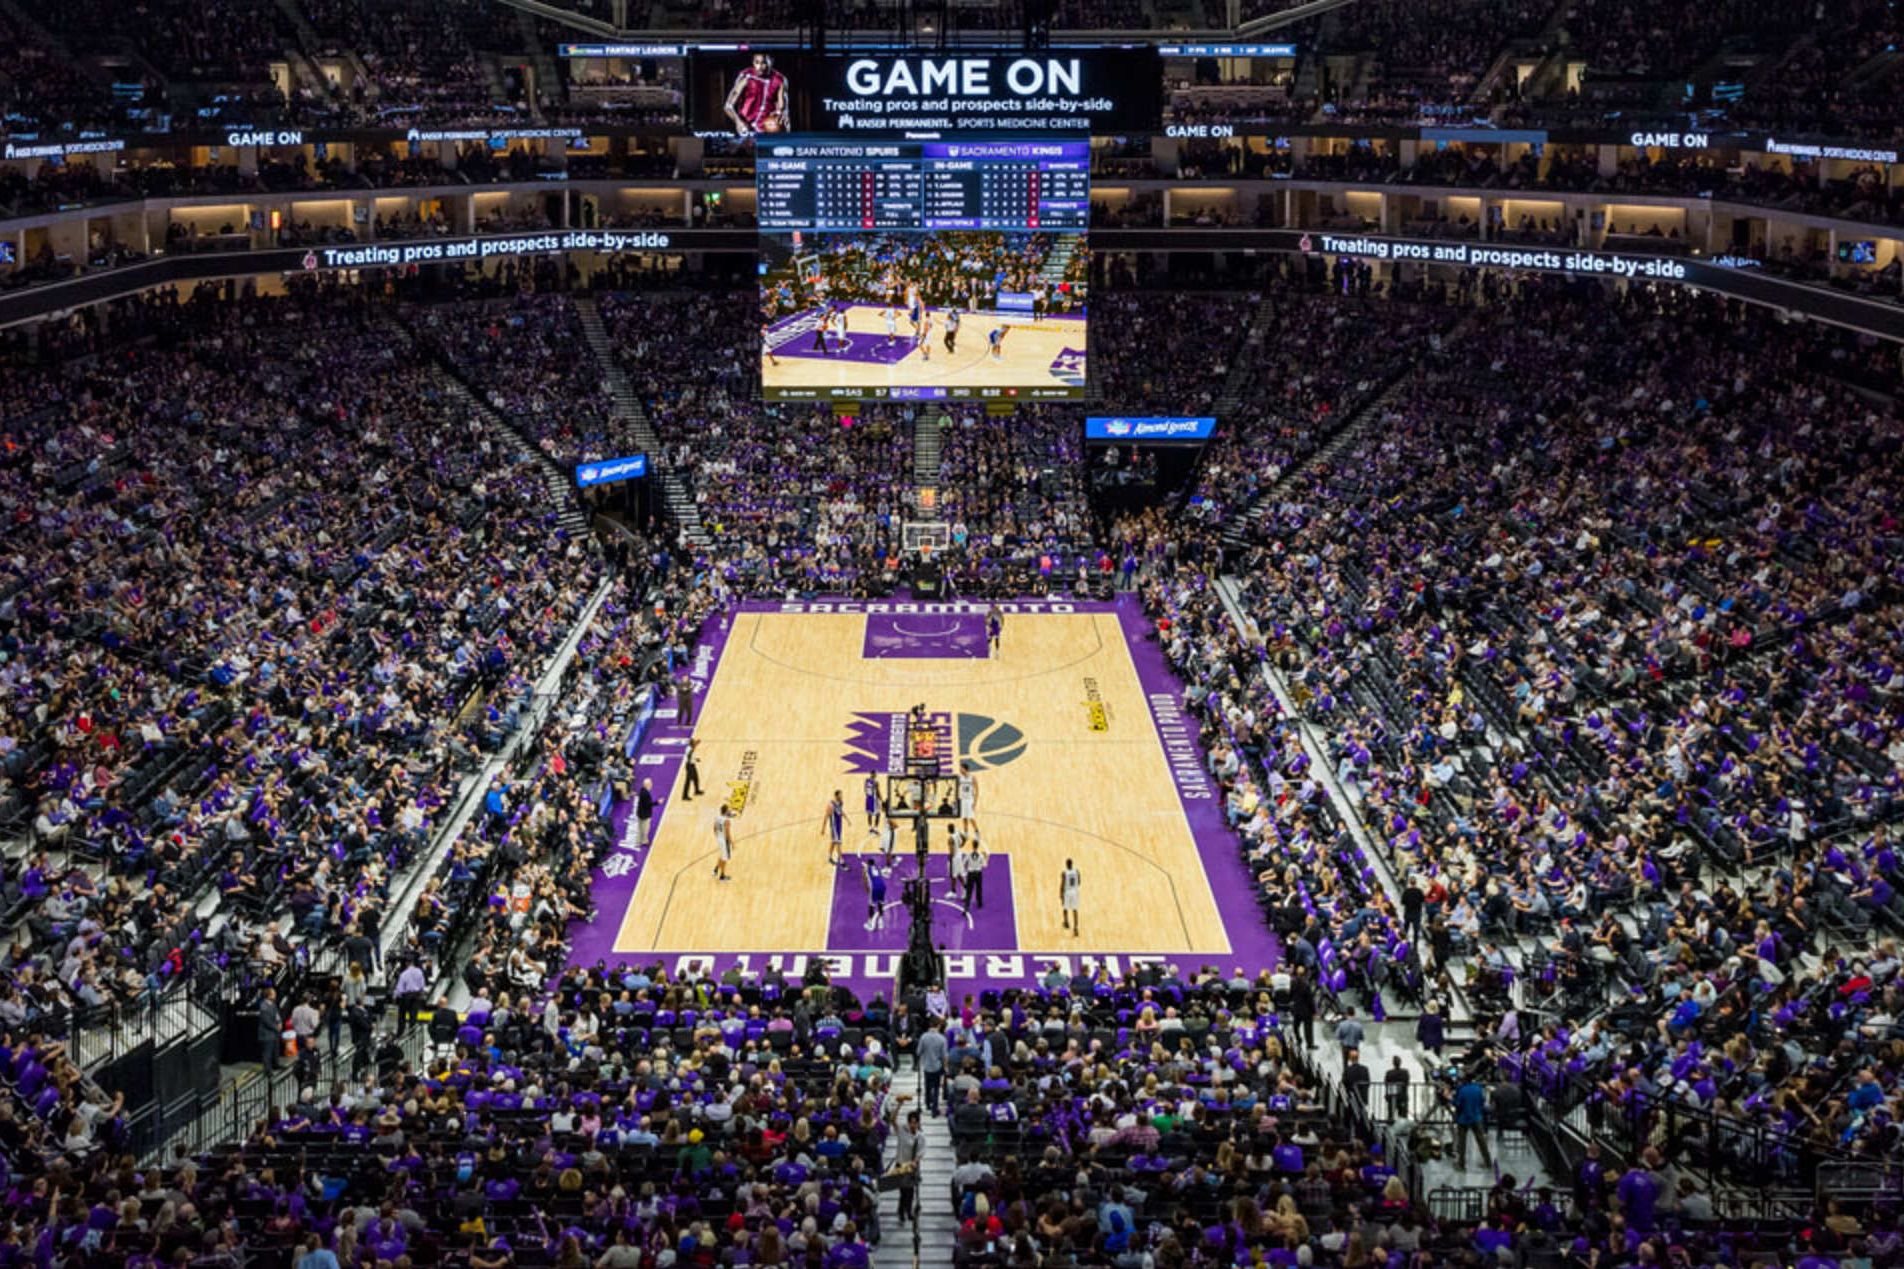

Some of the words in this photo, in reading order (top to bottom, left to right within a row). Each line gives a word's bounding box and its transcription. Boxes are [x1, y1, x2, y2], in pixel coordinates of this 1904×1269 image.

[846, 59, 990, 96] GAME
[1006, 59, 1081, 96] ON
[825, 98, 883, 113] Treating
[886, 100, 918, 113] pros
[921, 98, 948, 111] and
[951, 99, 1021, 113] prospects
[1025, 98, 1113, 113] side-by-side
[957, 117, 995, 128] SPORTS
[998, 117, 1047, 128] MEDICINE
[1050, 117, 1090, 128] CENTER
[1166, 125, 1207, 136] GAME
[1211, 125, 1233, 136] ON
[228, 133, 275, 145] GAME
[277, 131, 301, 144] ON
[1631, 133, 1679, 146] GAME
[1684, 134, 1708, 148] ON
[796, 147, 818, 156] SAN
[820, 147, 863, 156] ANTONIO
[961, 147, 1029, 156] SACRAMENTO
[325, 250, 399, 266] Treating
[404, 245, 442, 263] pros
[446, 240, 476, 257] and
[481, 236, 559, 257] prospects
[562, 230, 669, 251] side-by-side
[1321, 236, 1389, 258] Treating
[1393, 243, 1430, 261] pros
[1434, 245, 1467, 261] and
[1471, 248, 1560, 270] prospects
[1565, 253, 1685, 278] side-by-side
[780, 602, 1075, 614] SACRAMENTO
[1161, 726, 1212, 799] SACRAMENTO
